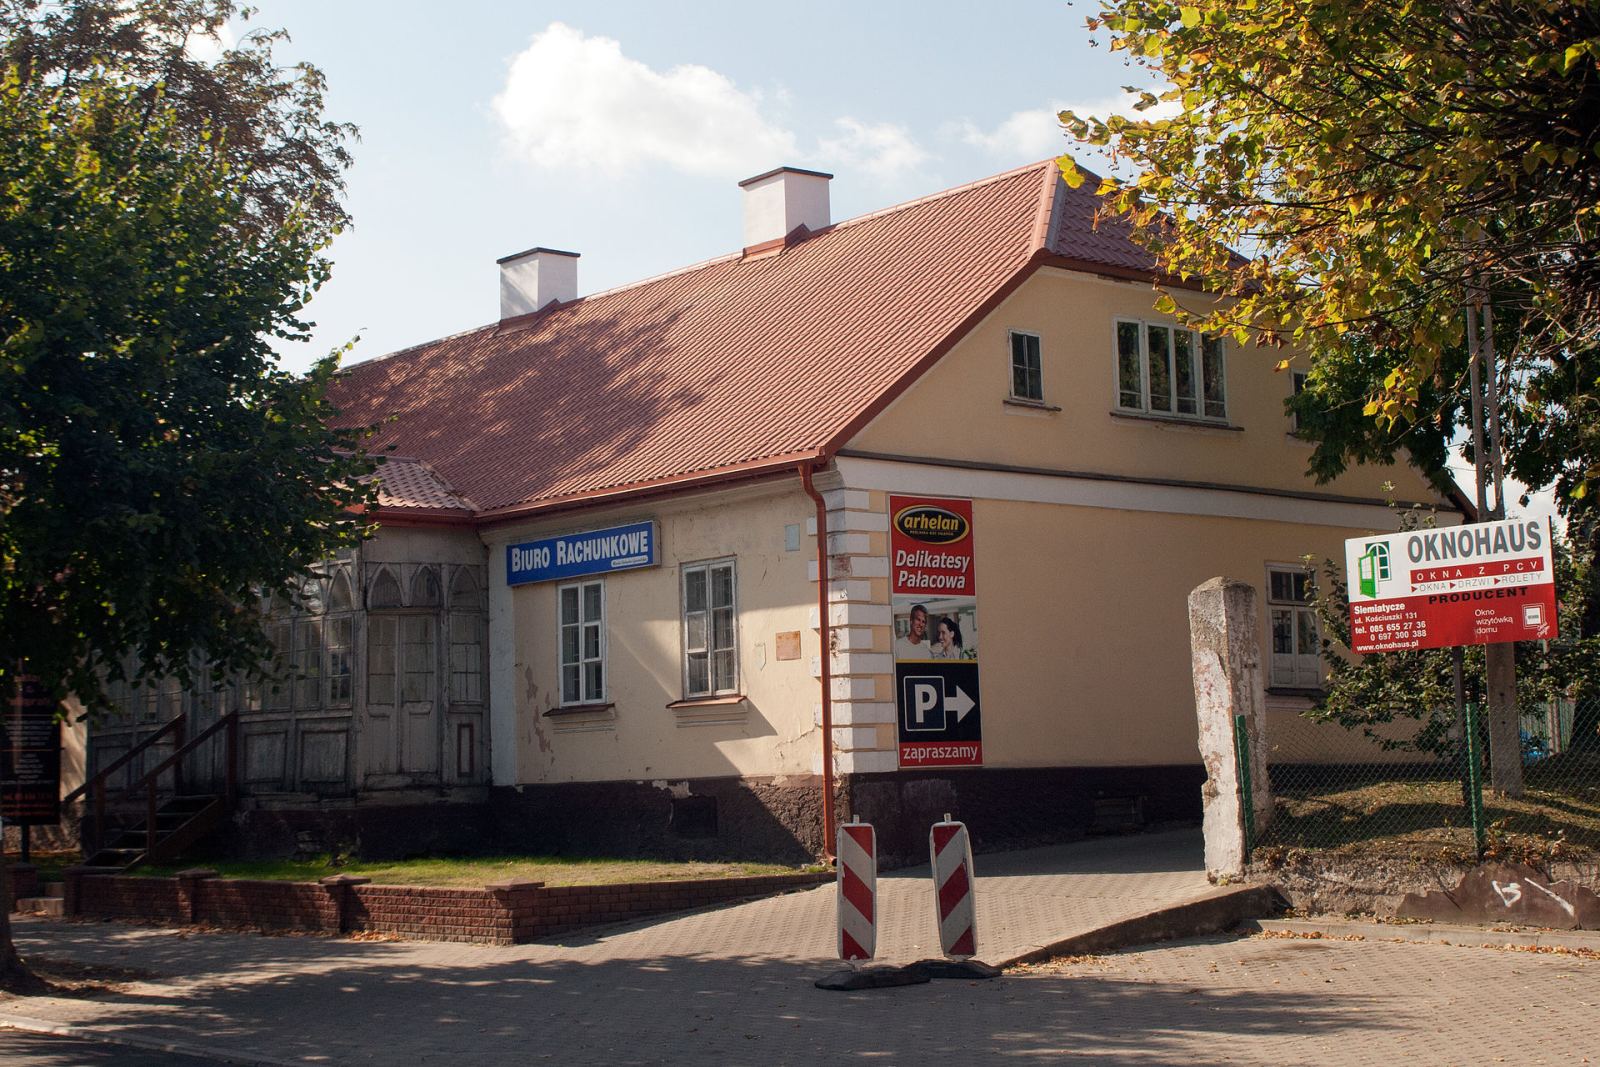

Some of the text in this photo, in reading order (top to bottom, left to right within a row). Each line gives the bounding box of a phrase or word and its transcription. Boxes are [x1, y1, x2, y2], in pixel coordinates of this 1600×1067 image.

[904, 514, 959, 530] arhelan
[1407, 521, 1541, 563] OKNOHAUS
[511, 531, 648, 572] BIURO RACHUNKOWE
[895, 550, 970, 573] Delikatesy
[898, 570, 965, 589] Pałacowa
[1416, 569, 1462, 581] OKNA
[1478, 566, 1485, 575] Z
[1419, 573, 1542, 592] OKNA DRZWI ROLETY
[1428, 587, 1528, 604] PRODUCENT
[1354, 603, 1405, 615] Siemiatycze
[1474, 609, 1495, 617] Okno
[1365, 613, 1402, 622] Kościuszki
[1475, 616, 1514, 626] wizytówką
[1355, 626, 1367, 634] tel.
[1369, 625, 1384, 633] 085
[1386, 623, 1400, 631] 655
[1403, 622, 1413, 630] 27
[1378, 632, 1392, 640] 697
[1395, 631, 1409, 639] 300
[1356, 640, 1418, 652] www.oknohaus.pl
[914, 683, 938, 723] P
[903, 746, 978, 763] zapraszamy
